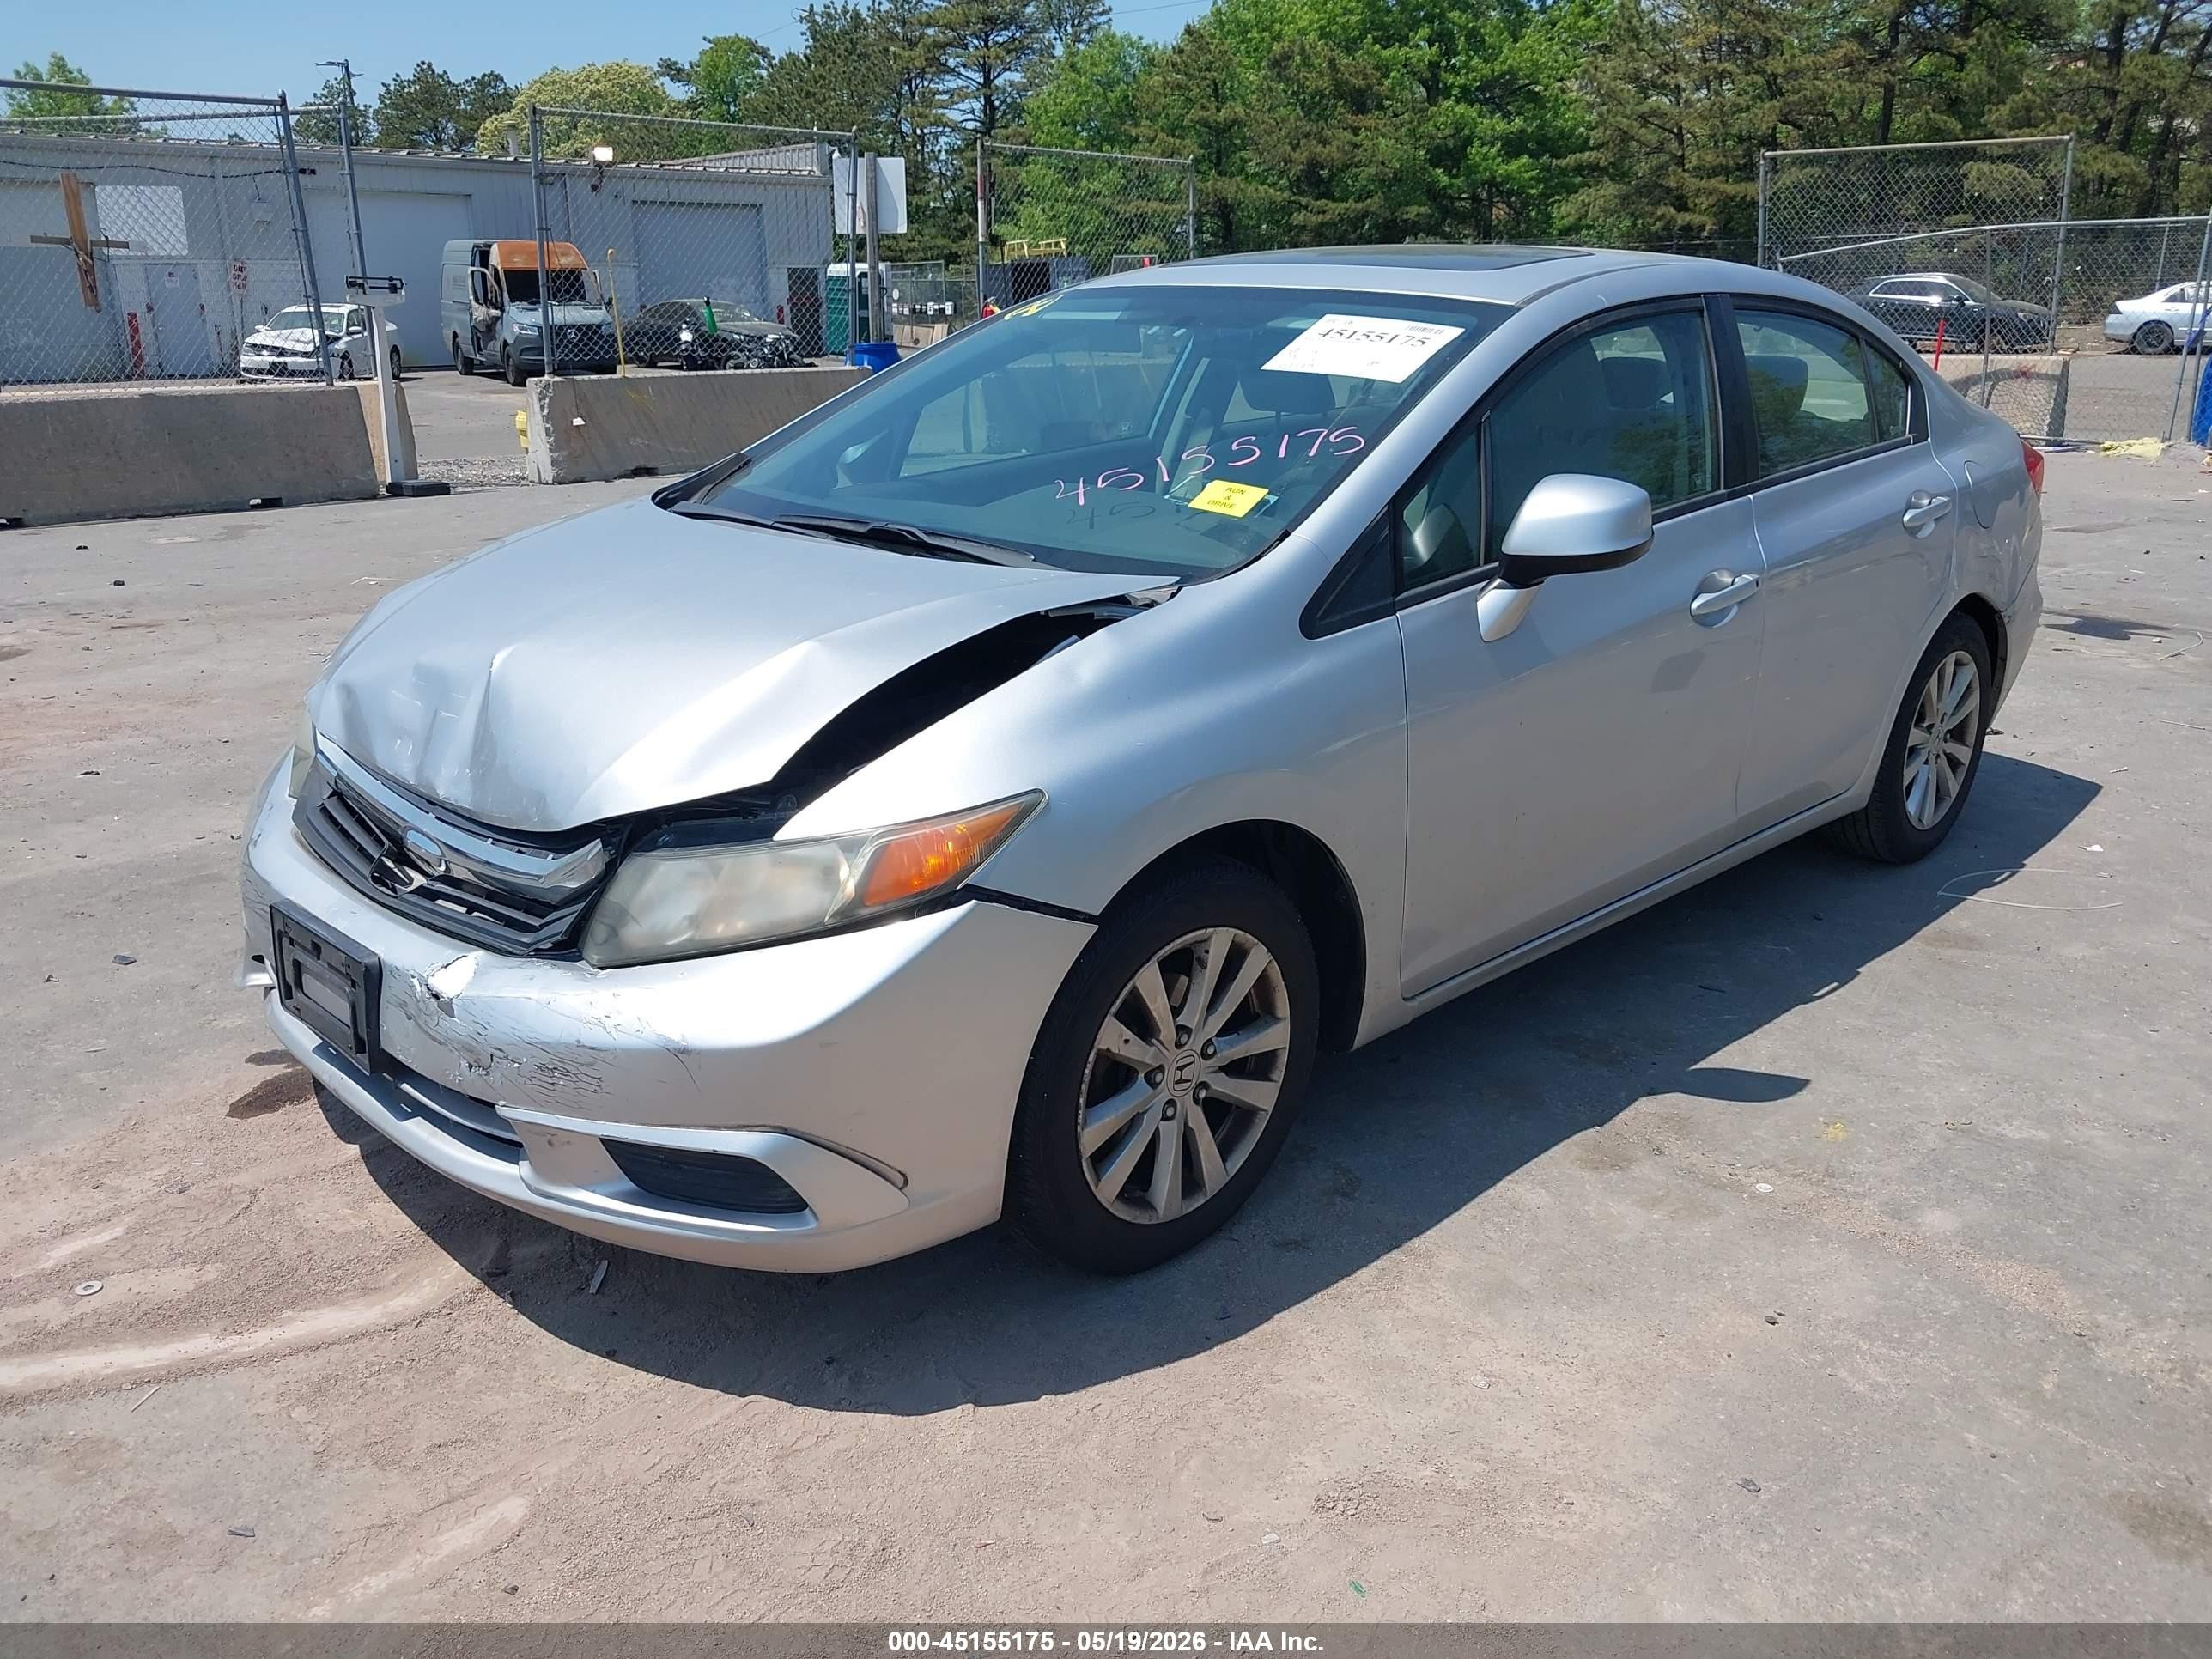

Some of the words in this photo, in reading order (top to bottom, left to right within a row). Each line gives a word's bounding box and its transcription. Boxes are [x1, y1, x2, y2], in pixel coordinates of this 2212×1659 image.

[1318, 328, 1431, 347] 45155175
[1055, 427, 1365, 506] 45155175
[1225, 487, 1247, 495] RUN
[1206, 500, 1237, 509] DRIVE
